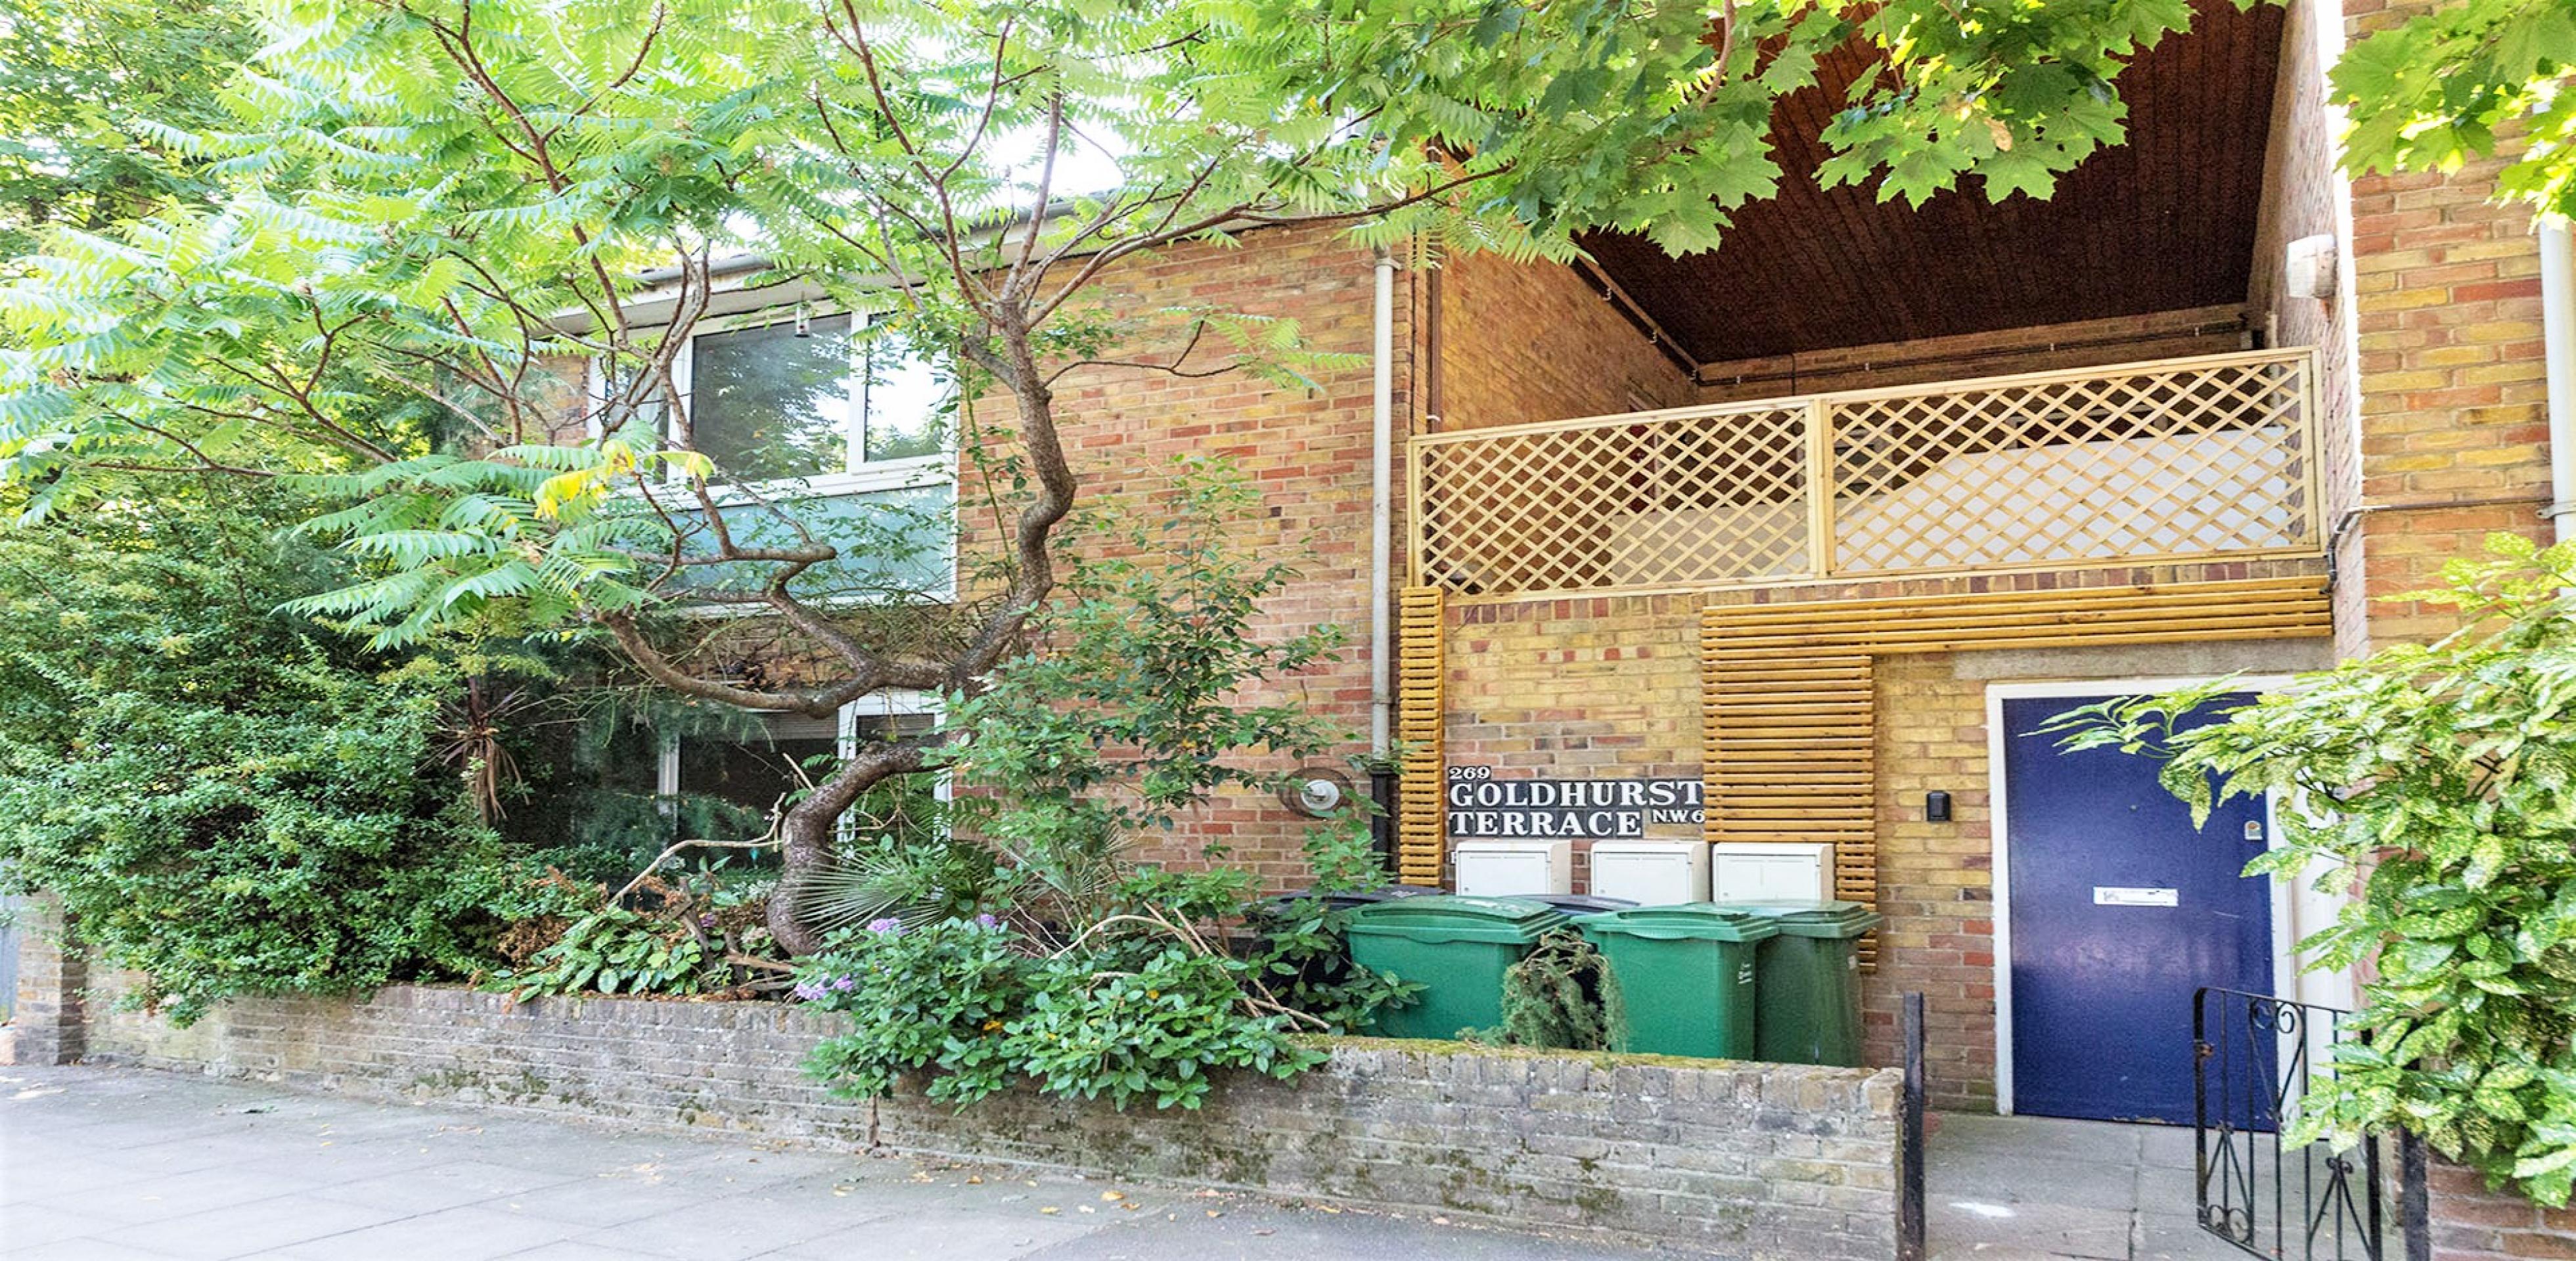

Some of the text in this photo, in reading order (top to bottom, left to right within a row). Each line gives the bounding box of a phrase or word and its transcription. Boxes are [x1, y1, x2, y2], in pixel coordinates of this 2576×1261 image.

[1449, 766, 1490, 780] 269
[1450, 782, 1705, 807] GOLDHURST
[1449, 811, 1640, 835] TERRACE
